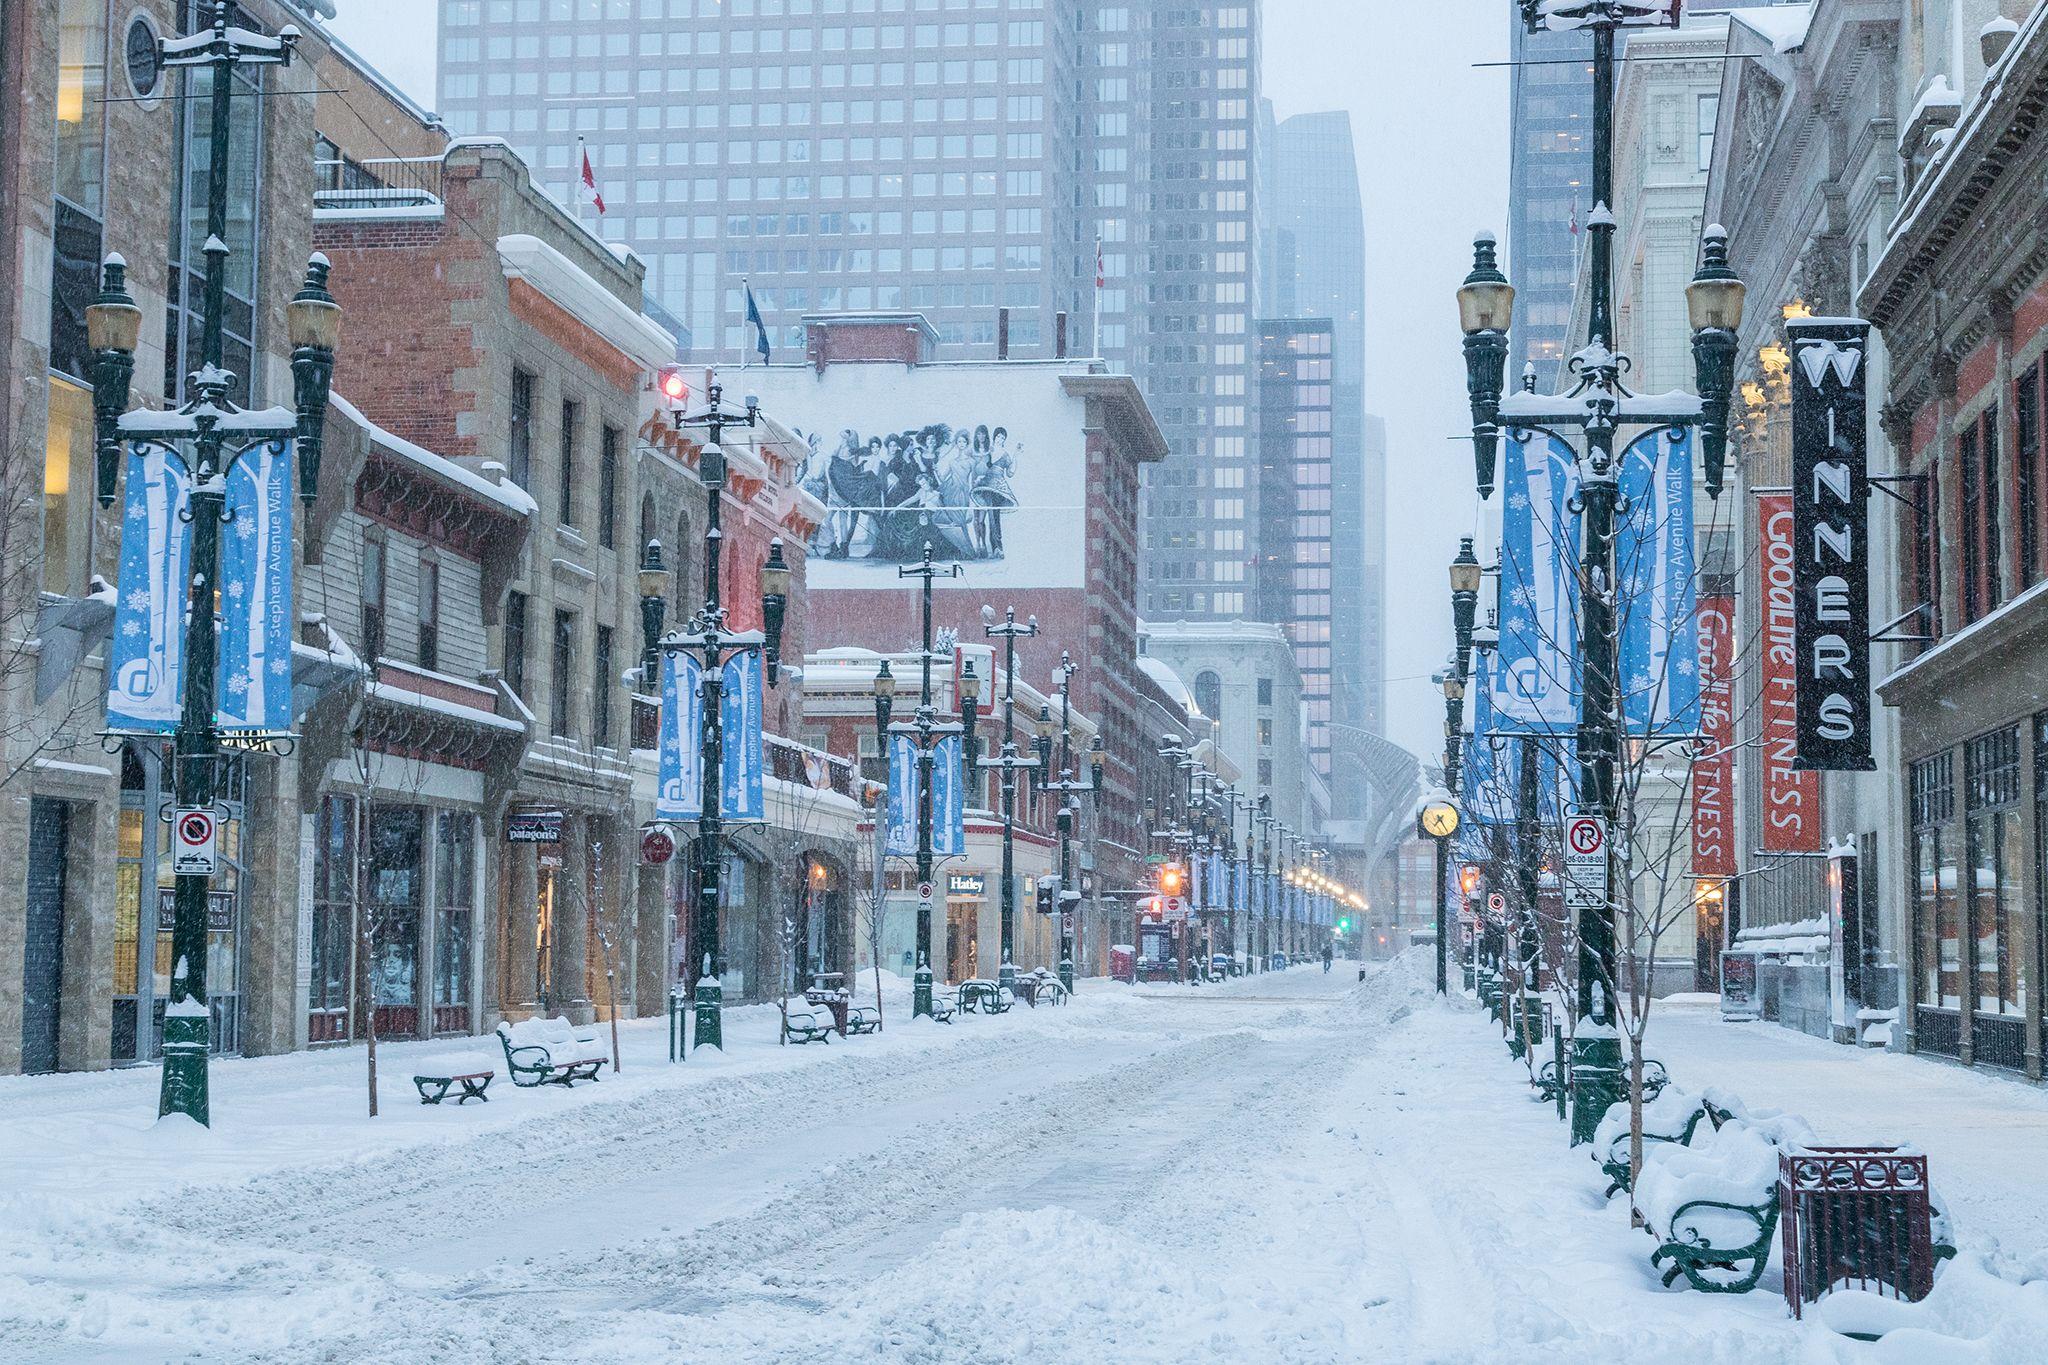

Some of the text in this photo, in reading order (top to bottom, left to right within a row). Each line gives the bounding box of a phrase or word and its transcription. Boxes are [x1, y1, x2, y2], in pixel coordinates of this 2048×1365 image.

[267, 477, 284, 638] Stephen Avenue Walk
[1667, 467, 1688, 637] Sphen Avenue Walk
[1798, 348, 1862, 740] WINNERS
[747, 693, 757, 727] Avenue
[748, 729, 758, 766] Stephen
[509, 829, 558, 841] patagonia
[950, 876, 983, 893] Hatley
